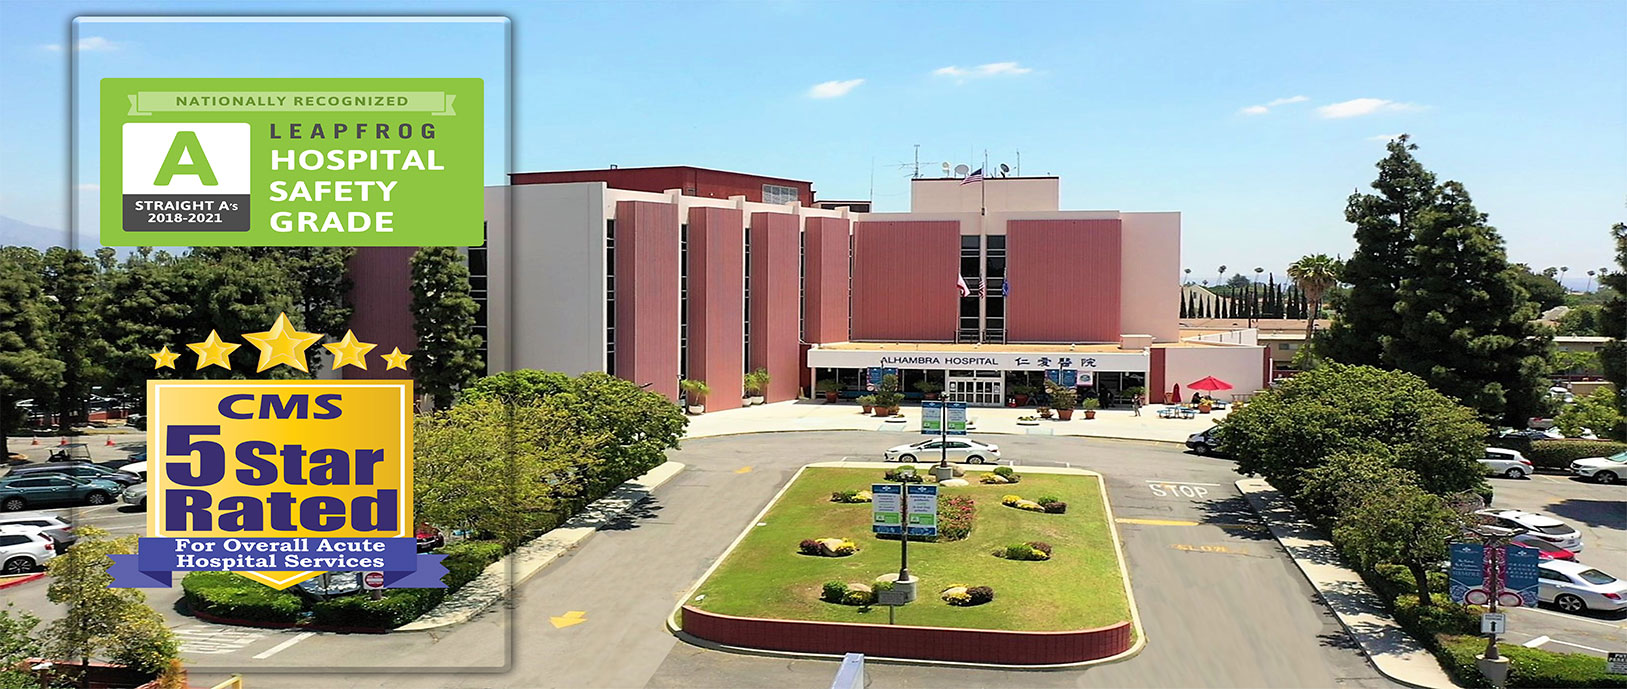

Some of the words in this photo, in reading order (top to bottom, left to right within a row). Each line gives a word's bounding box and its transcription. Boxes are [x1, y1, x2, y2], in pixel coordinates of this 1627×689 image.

[881, 356, 940, 365] ALHAMBRA
[945, 357, 999, 366] HOSPITAL
[1149, 484, 1208, 498] STOP
